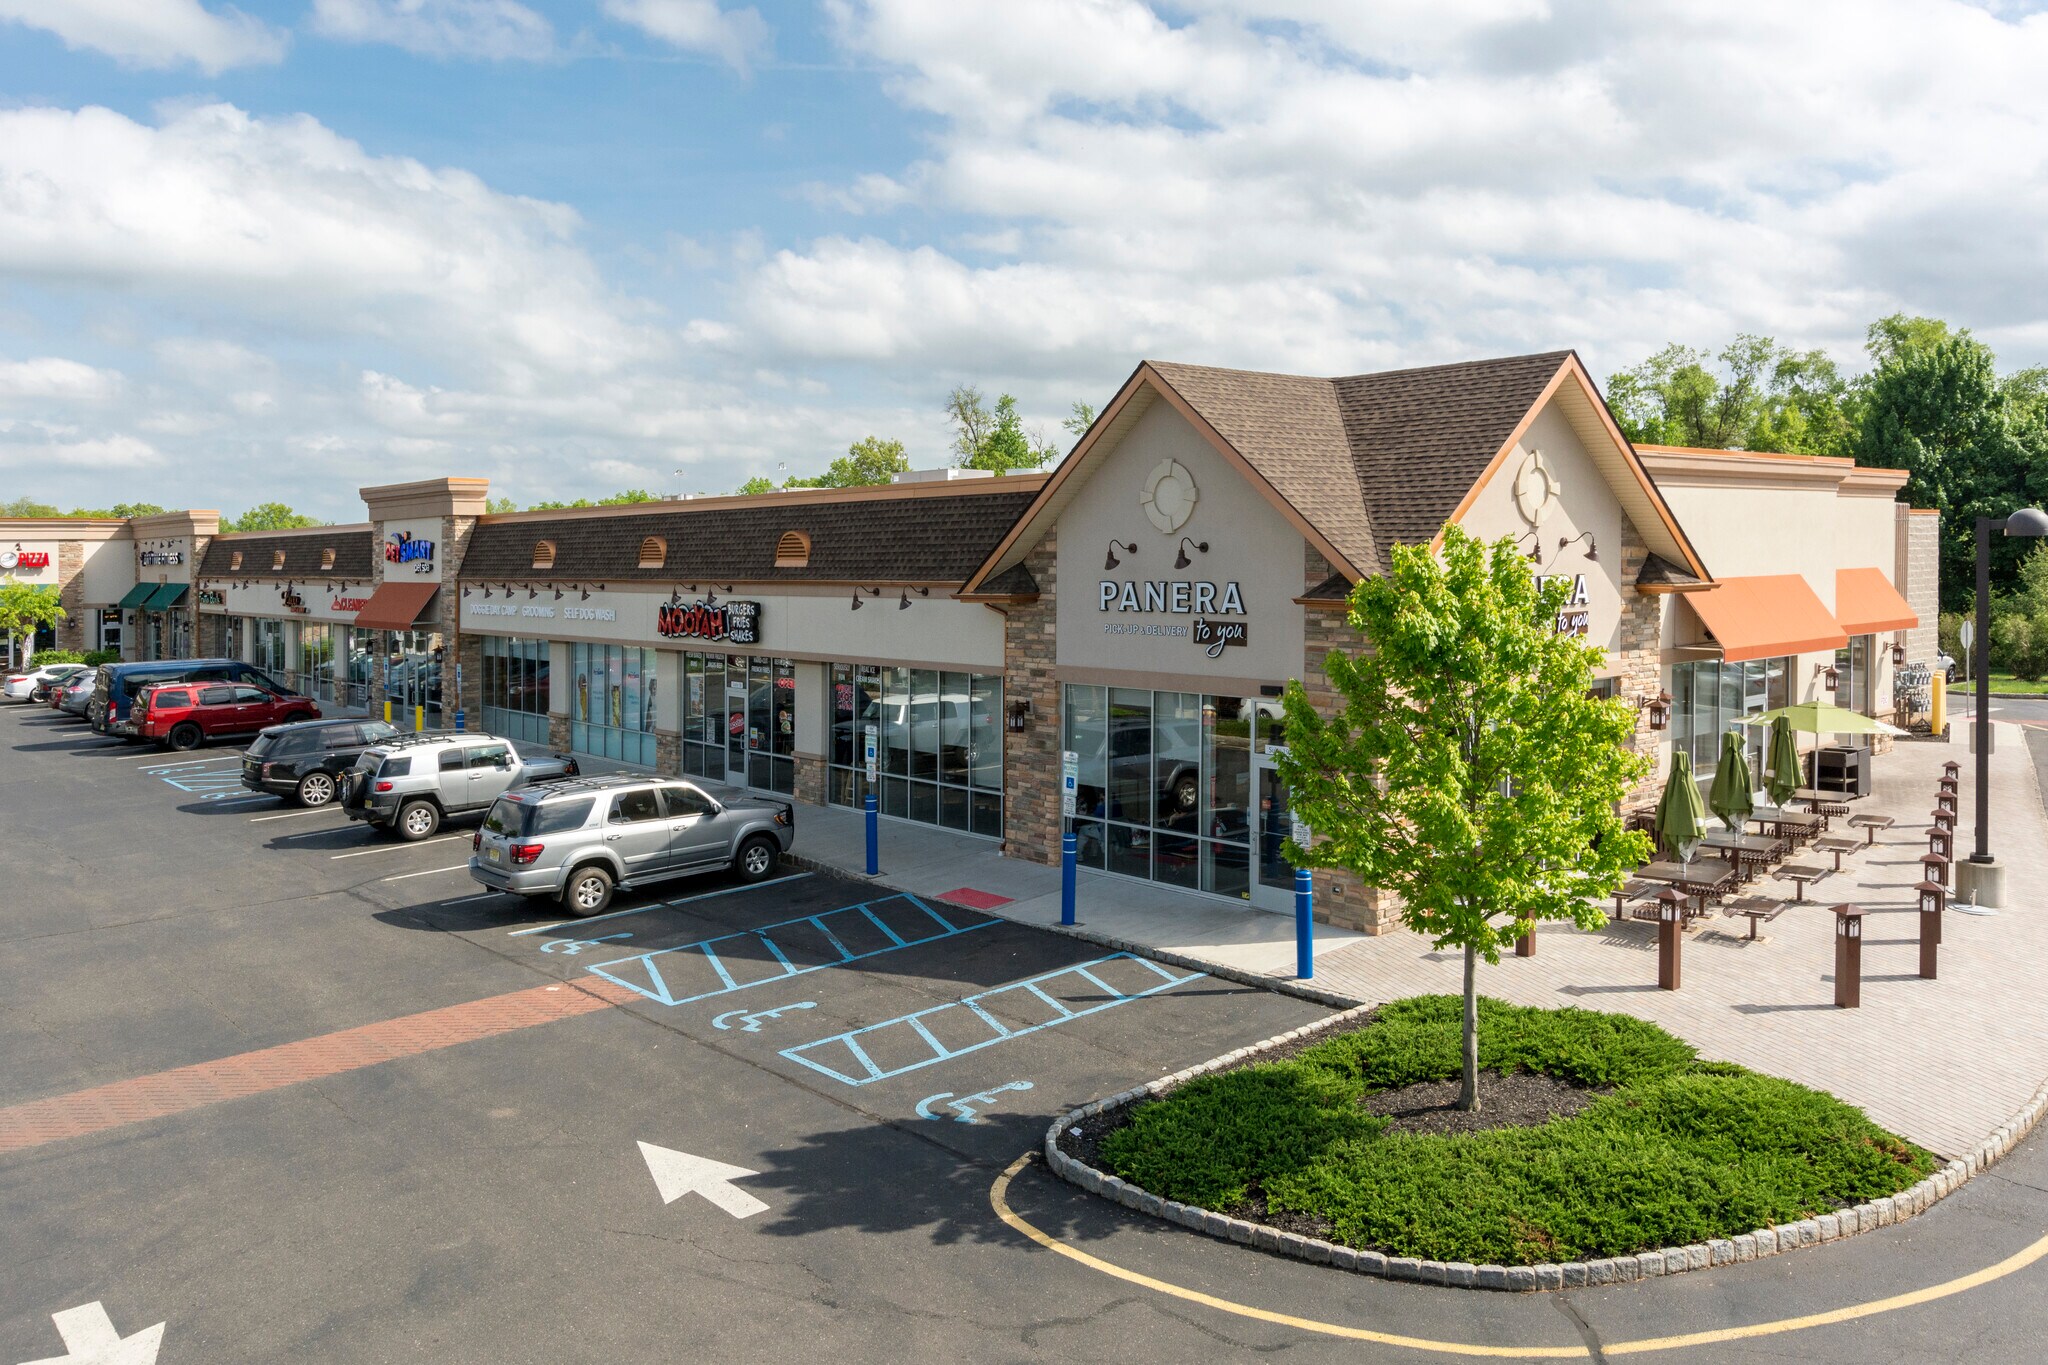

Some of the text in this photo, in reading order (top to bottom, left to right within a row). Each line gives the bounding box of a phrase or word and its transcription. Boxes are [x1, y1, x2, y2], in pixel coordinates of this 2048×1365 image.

[18, 552, 49, 567] PIZZA
[1099, 580, 1247, 615] PANERA
[501, 605, 517, 616] CAMP
[521, 605, 555, 618] GROOMING
[563, 607, 616, 622] SELF DOG WASH
[727, 603, 755, 616] BURGERS
[657, 602, 726, 640] MOOYAH
[732, 616, 750, 628] FRIES
[1557, 610, 1589, 640] to you
[729, 630, 754, 642] SHAKES
[1104, 623, 1189, 637] PICK-UP & DELIVERY
[1196, 617, 1244, 658] to you
